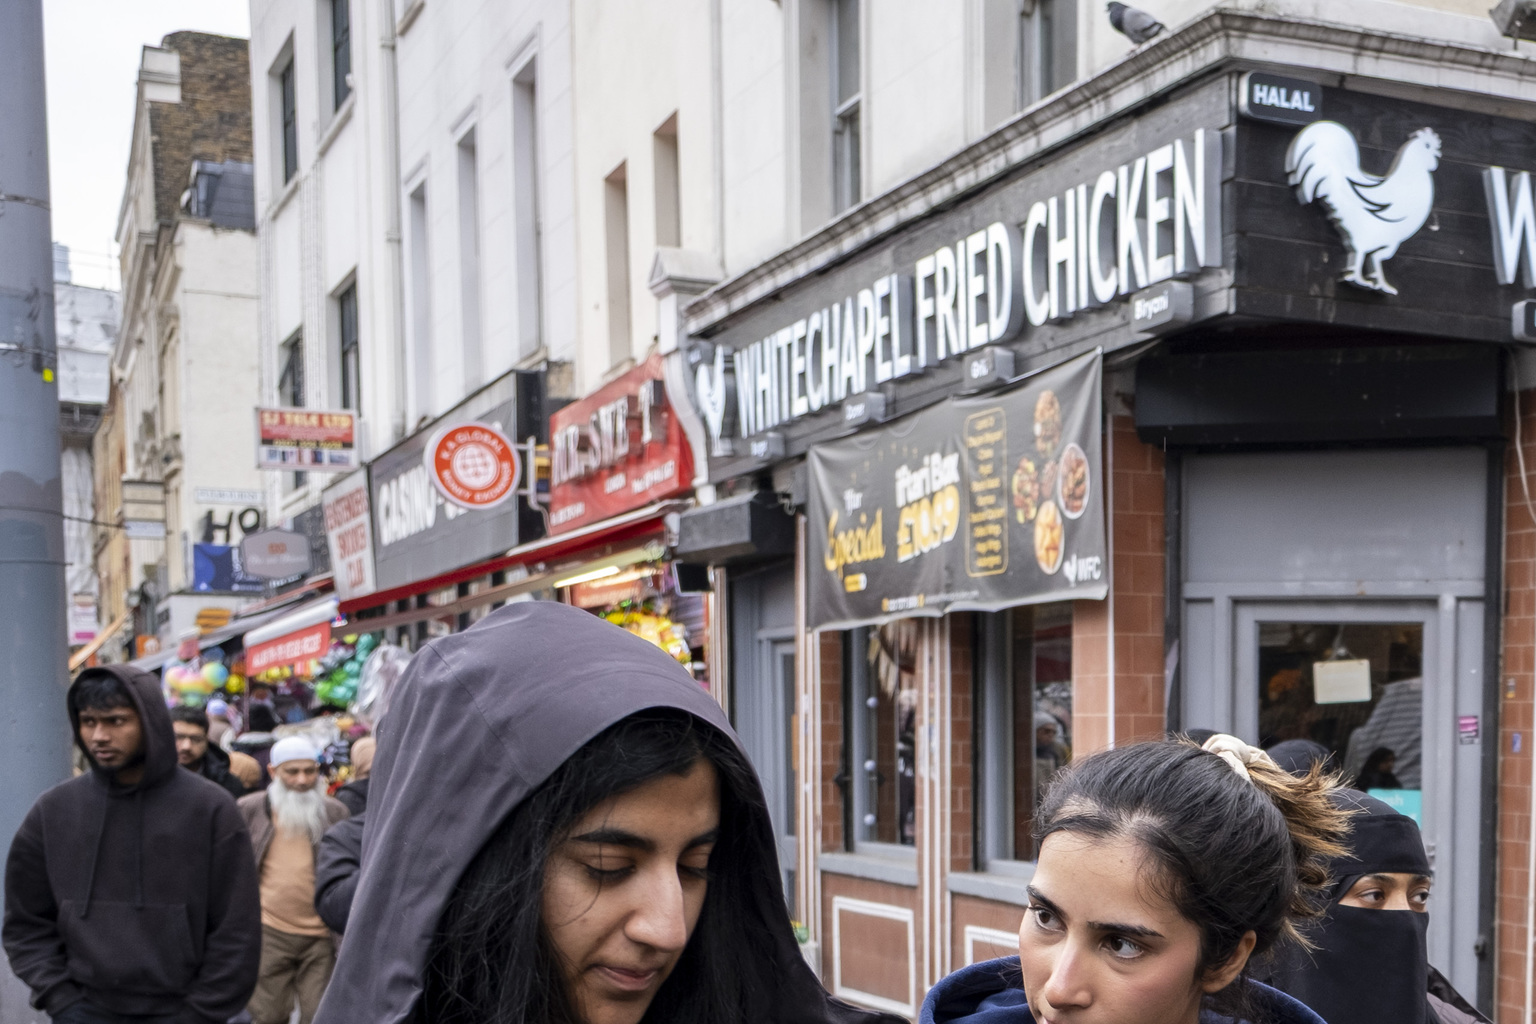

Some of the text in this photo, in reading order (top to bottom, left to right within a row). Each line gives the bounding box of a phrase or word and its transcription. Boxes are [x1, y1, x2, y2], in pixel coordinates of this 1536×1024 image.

[1253, 83, 1315, 113] HALAL
[734, 129, 1206, 439] WHITECHAPEL FRIED CHICKEN
[1077, 555, 1102, 582] WFC
